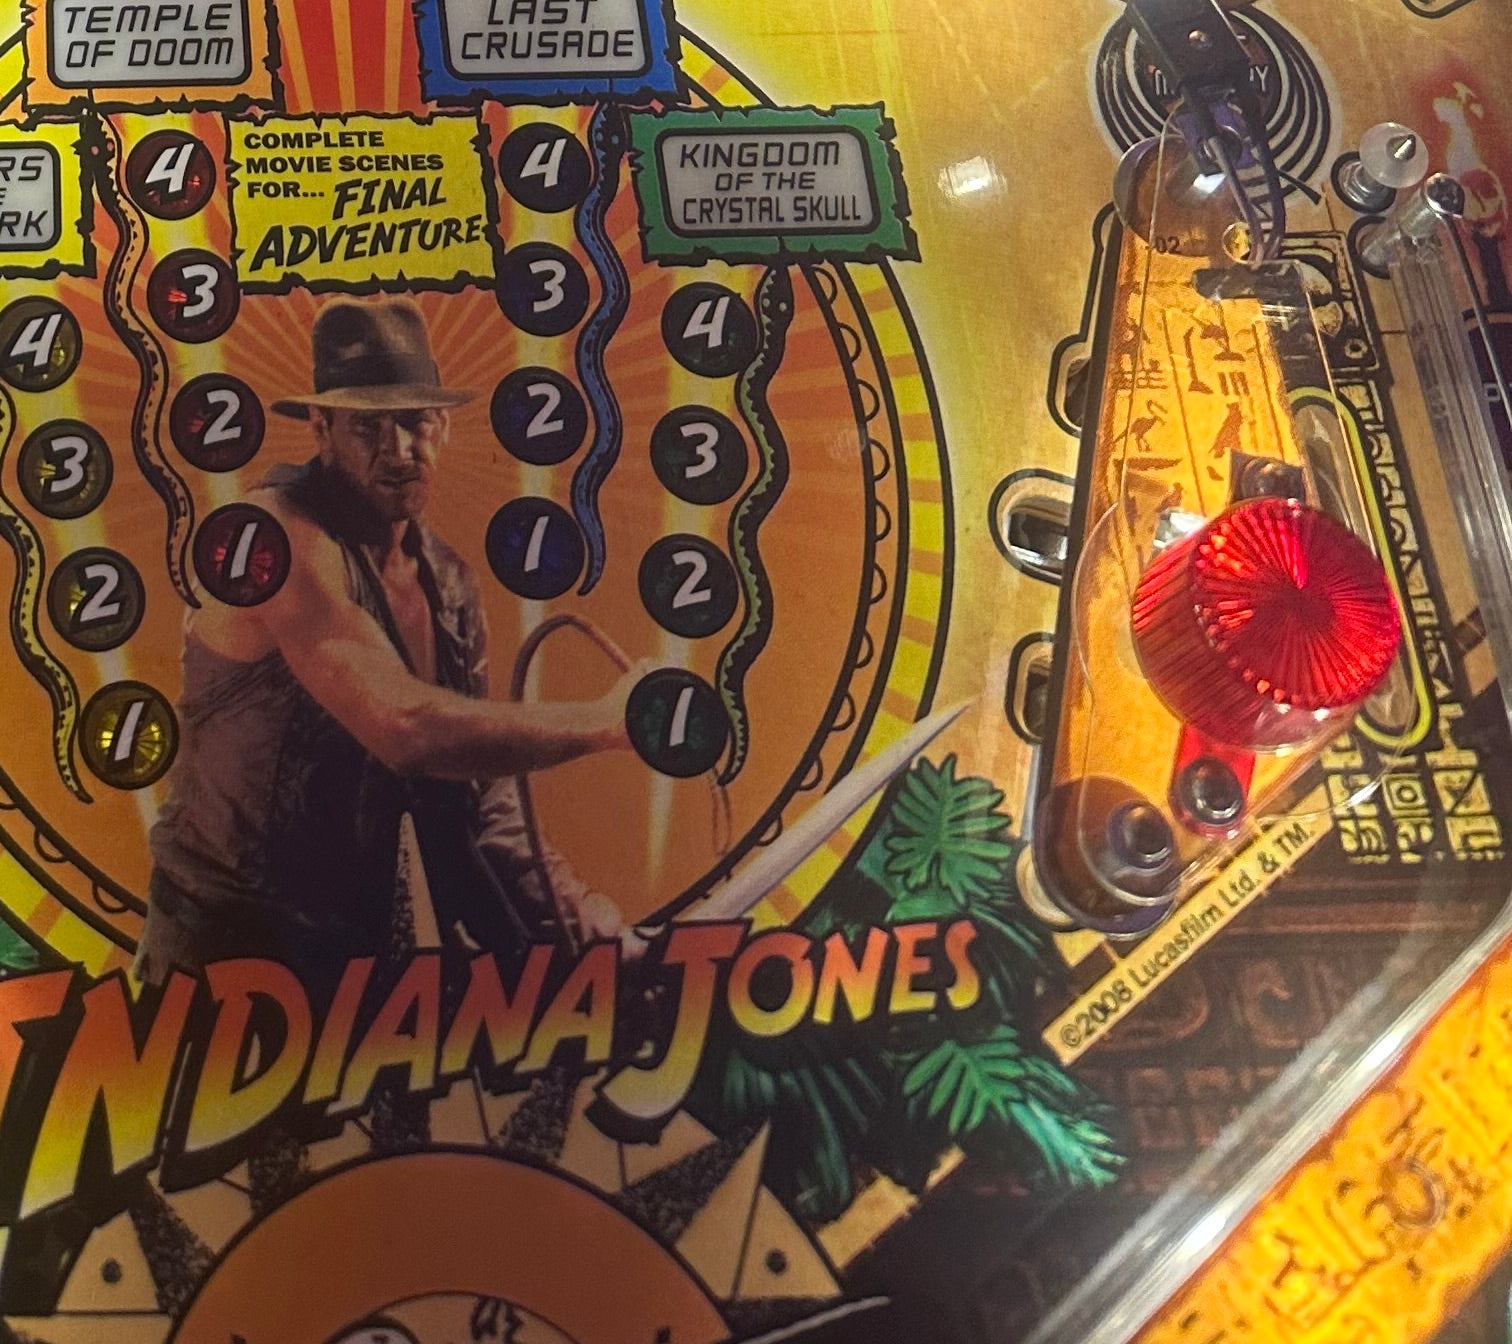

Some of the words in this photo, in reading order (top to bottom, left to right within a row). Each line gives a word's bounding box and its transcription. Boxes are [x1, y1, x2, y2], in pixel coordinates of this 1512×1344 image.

[64, 2, 234, 35] TEMPLE
[460, 28, 636, 61] CRUSADE
[65, 38, 116, 68] OF
[127, 36, 234, 67] DOOM
[145, 142, 196, 194] 4
[243, 130, 385, 150] COMPLETE
[245, 155, 333, 174] MOVIE
[337, 153, 445, 172] SCENES
[519, 137, 569, 188] 4
[679, 140, 841, 169] KINGDOM
[247, 180, 326, 199] FOR...
[331, 175, 447, 222] FINAL
[714, 171, 755, 192] OF
[761, 170, 817, 191] THE
[682, 194, 786, 225] CRYSTAL
[792, 194, 862, 223] SKULL
[248, 213, 484, 273] ADVENTURE
[181, 262, 220, 319] 3
[528, 259, 567, 314] 3
[9, 312, 63, 368] 4
[682, 295, 728, 350] 4
[202, 388, 244, 446] 2
[525, 382, 565, 440] 2
[49, 434, 90, 495] 3
[679, 421, 721, 480] 3
[229, 521, 260, 580] 1
[523, 515, 550, 574] 1
[79, 562, 121, 624] 2
[672, 549, 713, 611] 2
[113, 700, 145, 763] 1
[668, 685, 695, 749] 1
[1059, 978, 1134, 1048] ©2008
[1128, 902, 1225, 988] Lucasfilm
[1217, 867, 1263, 910] Ltd.
[1255, 850, 1282, 875] &
[594, 918, 983, 1122] JONES
